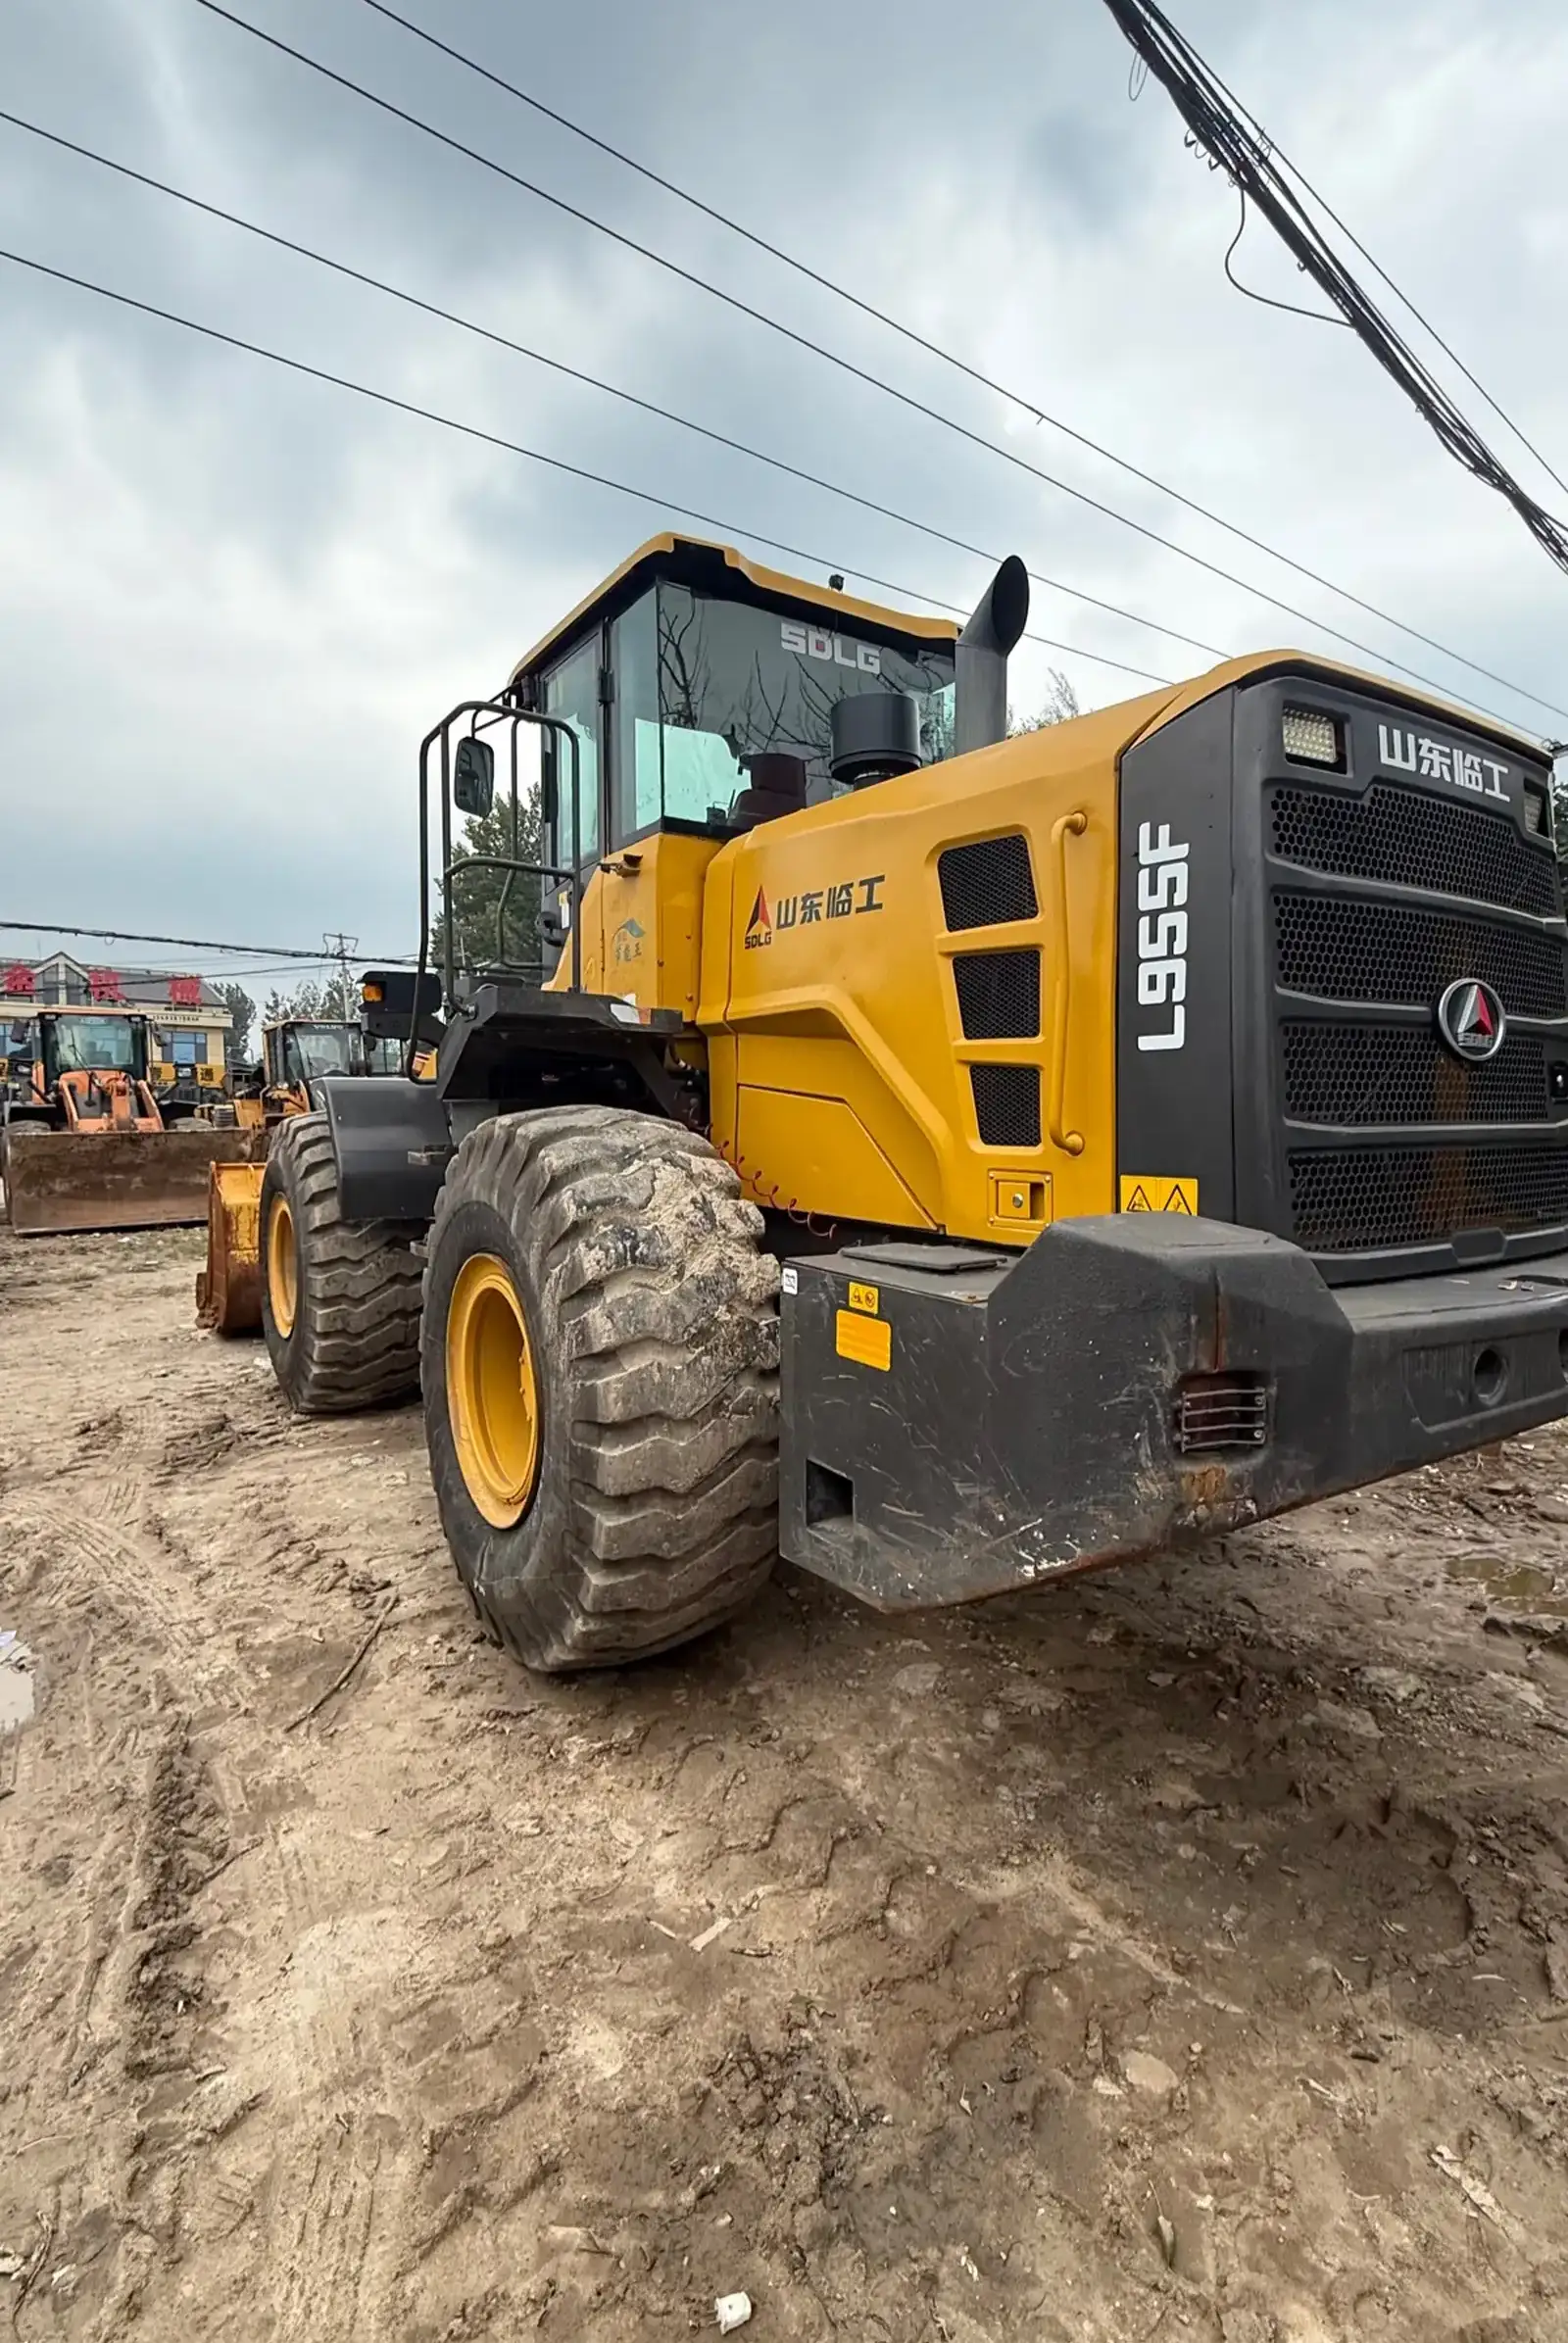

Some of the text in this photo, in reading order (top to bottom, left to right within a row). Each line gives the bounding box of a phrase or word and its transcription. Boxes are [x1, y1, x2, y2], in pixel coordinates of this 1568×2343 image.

[781, 622, 881, 674] SDLG
[1378, 724, 1510, 803] 山东临工
[776, 874, 885, 930] 山东临工
[745, 931, 771, 950] SDLG
[1137, 820, 1190, 1051] L955F
